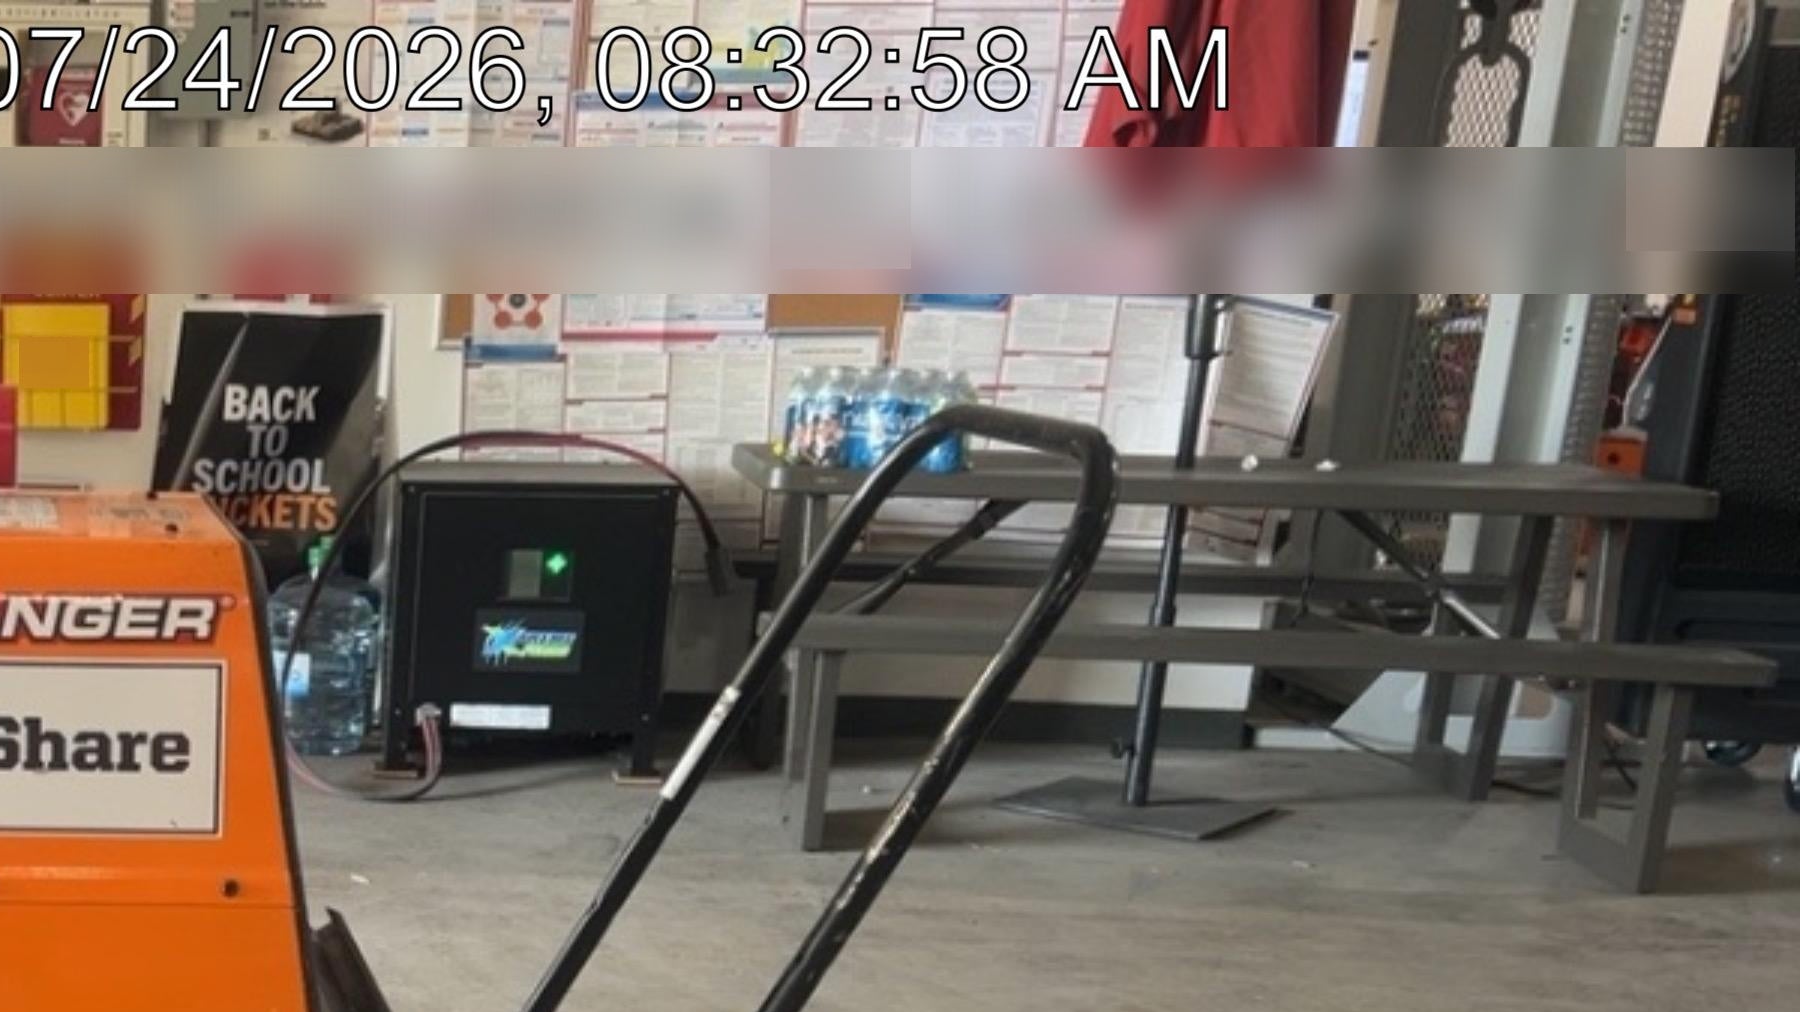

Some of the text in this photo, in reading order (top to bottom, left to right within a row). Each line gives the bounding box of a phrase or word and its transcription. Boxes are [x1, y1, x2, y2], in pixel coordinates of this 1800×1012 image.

[223, 383, 319, 423] BACK
[247, 424, 290, 459] TO
[193, 458, 331, 494] SCHOOL
